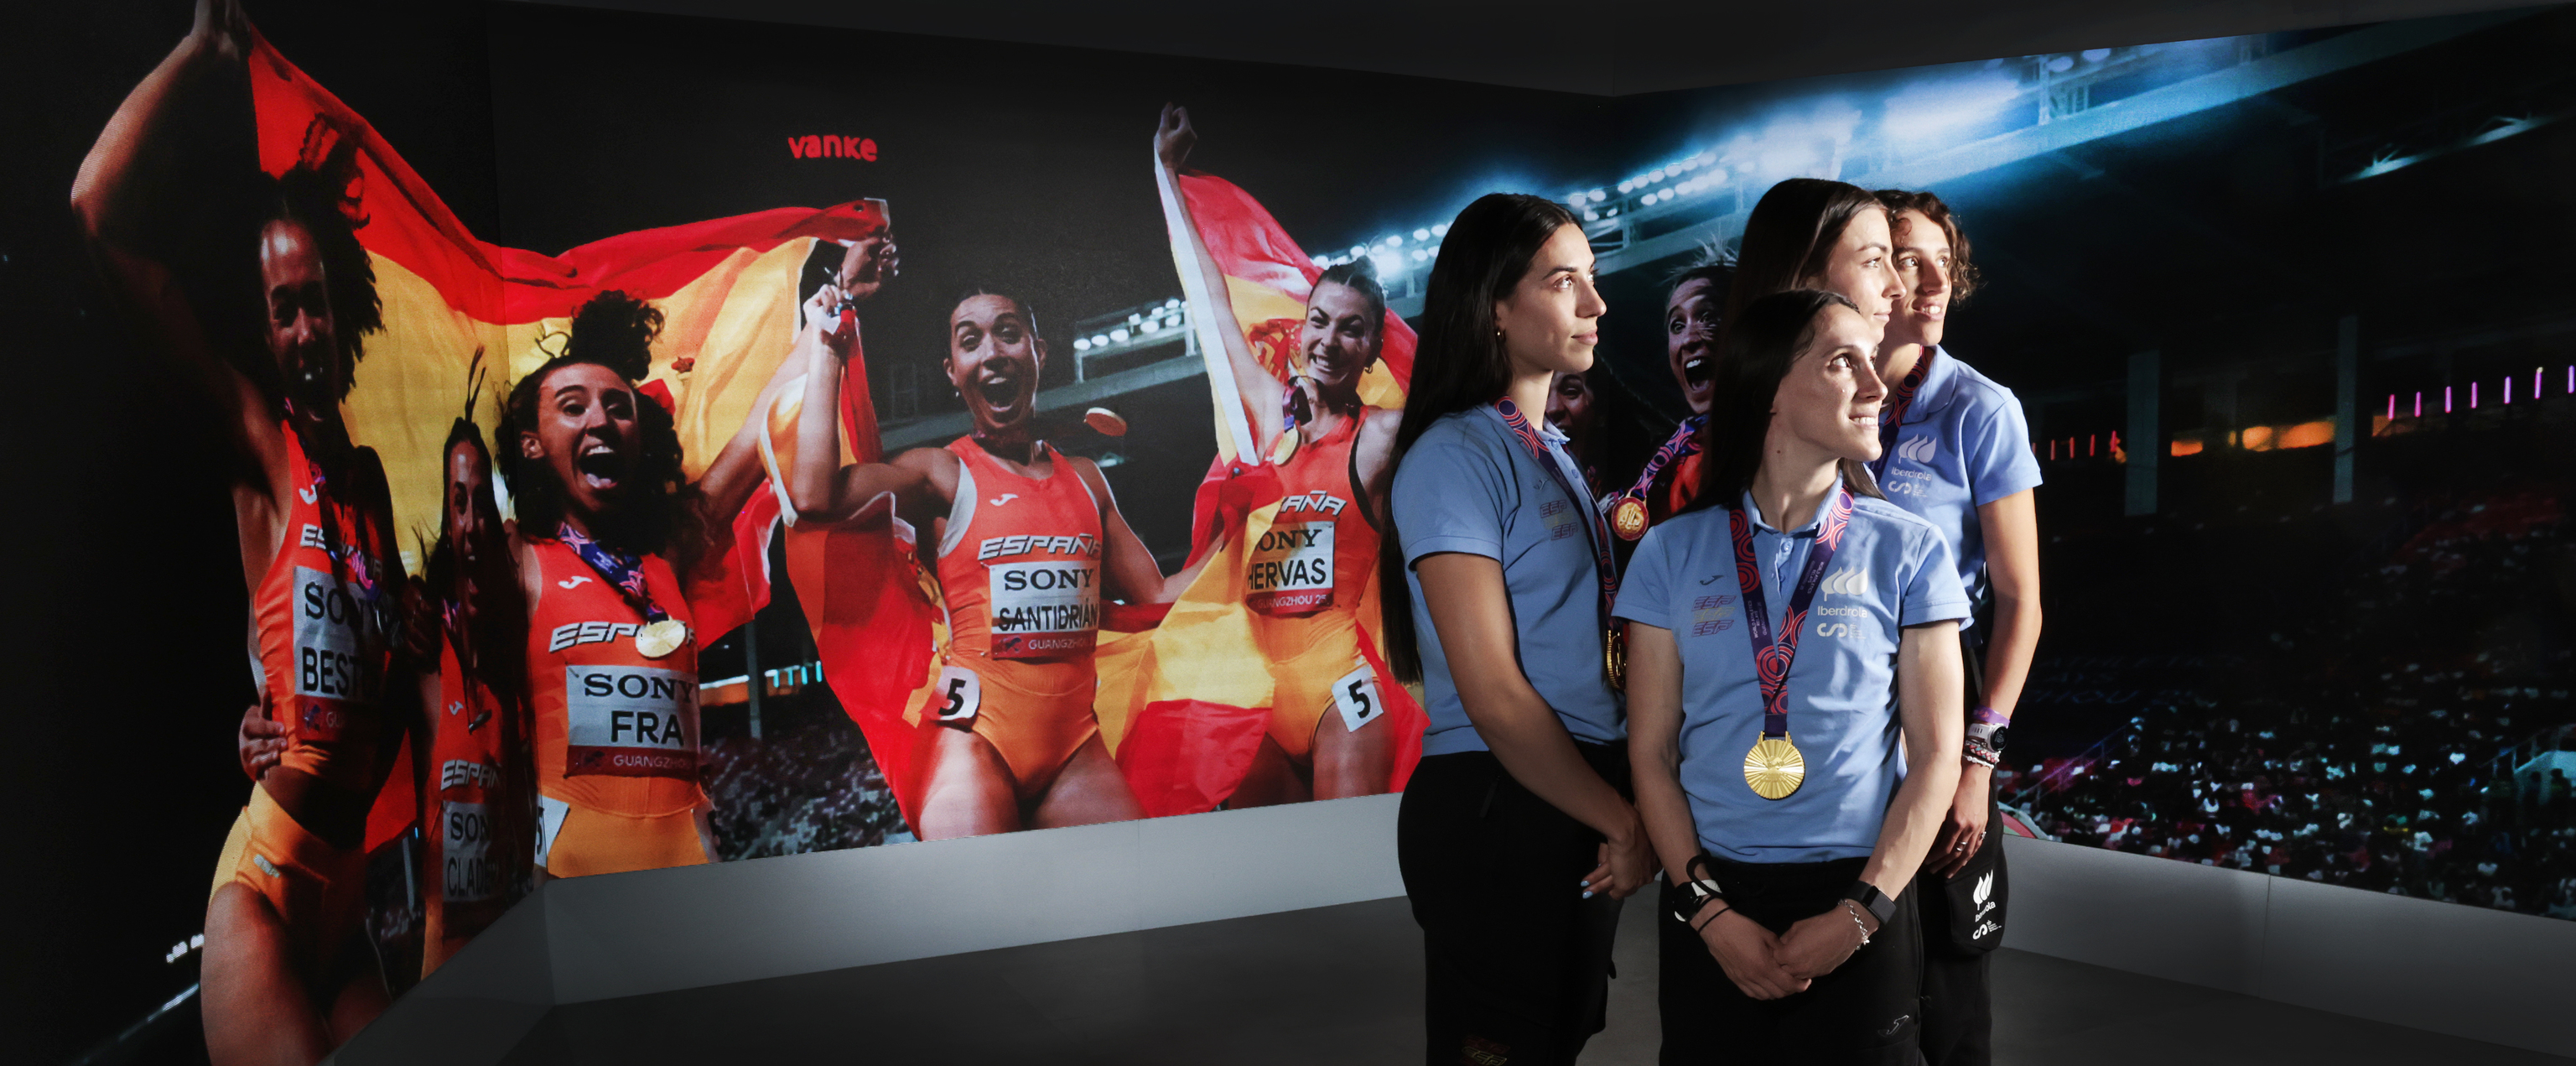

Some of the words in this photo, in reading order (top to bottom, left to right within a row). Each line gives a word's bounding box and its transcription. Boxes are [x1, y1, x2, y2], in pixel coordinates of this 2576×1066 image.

[788, 134, 878, 162] vanke
[1891, 466, 1932, 481] Iberdrola
[1254, 528, 1322, 553] ONY
[1004, 569, 1094, 591] SONY
[1817, 606, 1868, 618] Iberdrola
[584, 673, 694, 703] SONY
[937, 678, 967, 716] 5
[1348, 679, 1371, 719] 5
[610, 710, 684, 746] FRA
[450, 812, 491, 842] SON
